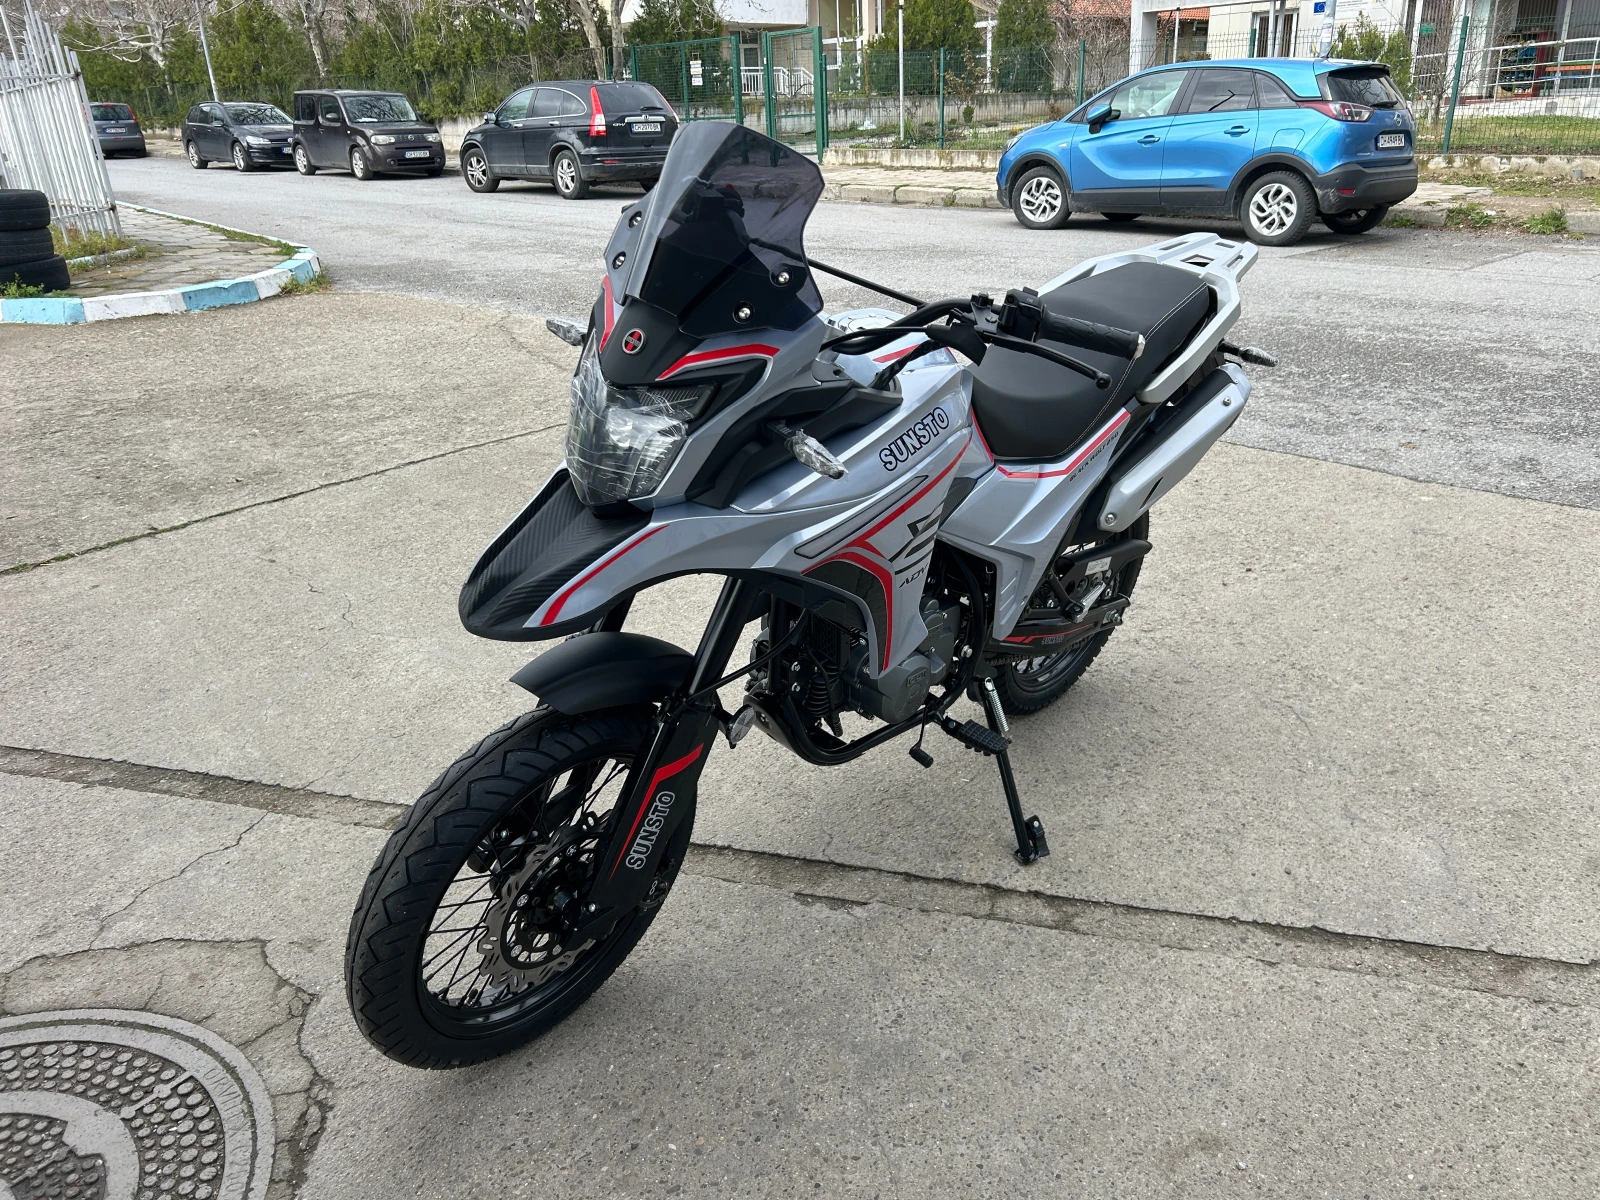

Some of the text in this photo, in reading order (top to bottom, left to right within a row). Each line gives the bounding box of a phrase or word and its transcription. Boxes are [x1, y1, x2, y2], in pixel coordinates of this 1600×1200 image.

[879, 407, 949, 471] SUNSTO
[1041, 634, 1065, 645] SUNSTO
[626, 791, 675, 869] SUNSTO
